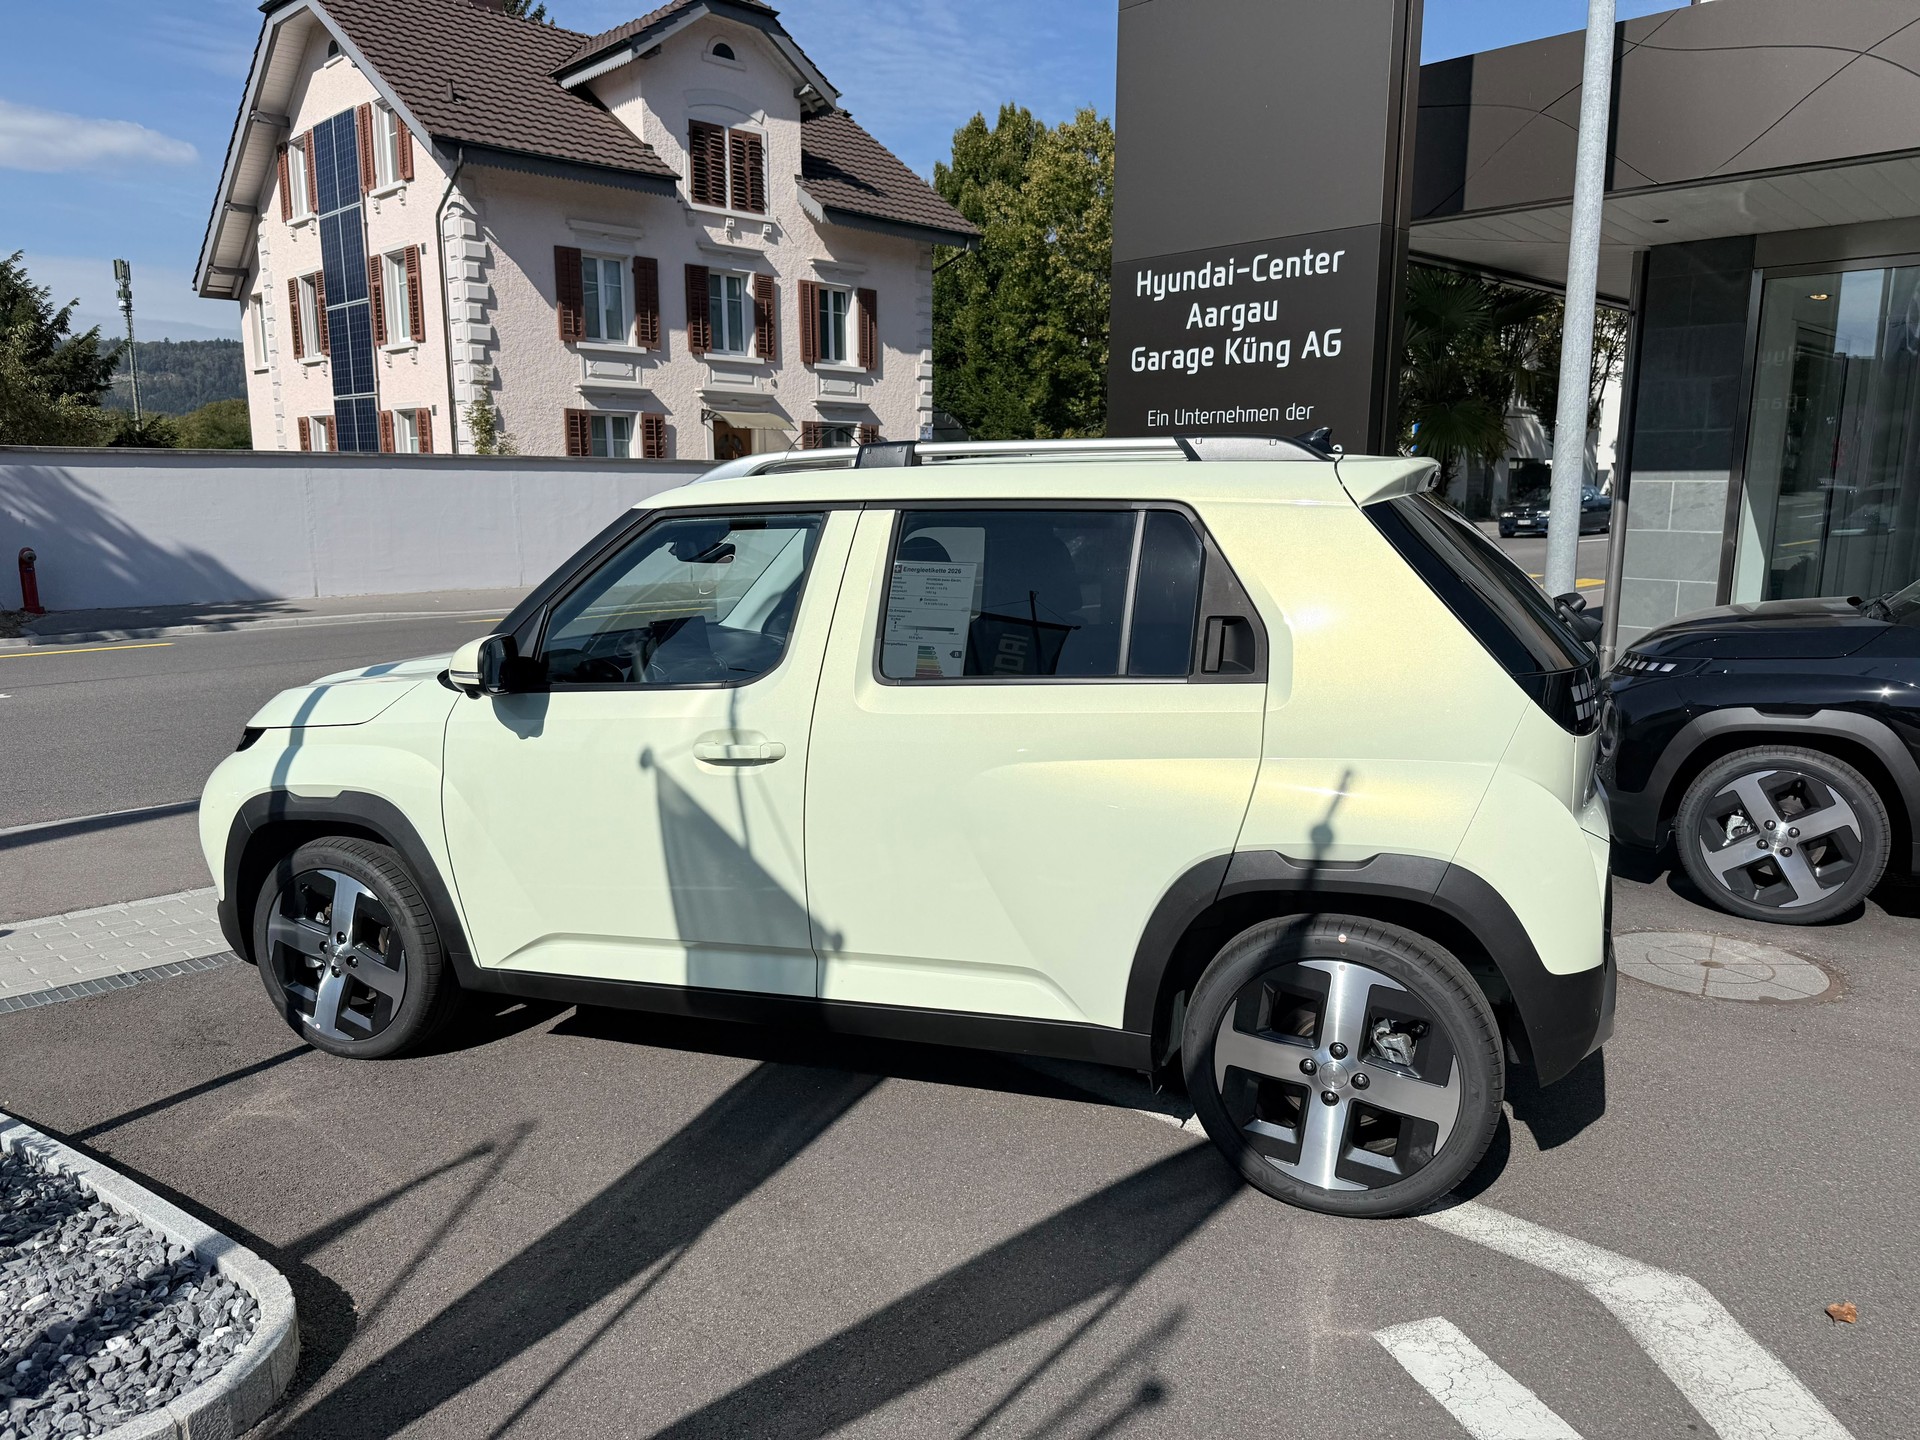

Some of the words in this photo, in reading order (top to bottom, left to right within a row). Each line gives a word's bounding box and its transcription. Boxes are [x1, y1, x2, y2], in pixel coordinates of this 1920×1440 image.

[1136, 248, 1345, 302] Hyundai-Center
[1186, 300, 1278, 331] Aargau
[1131, 346, 1215, 375] Garage
[1225, 337, 1291, 369] Küng
[1301, 328, 1342, 359] AG
[1147, 409, 1169, 427] Ein
[1174, 406, 1279, 426] Unternehmen
[1286, 402, 1314, 421] der
